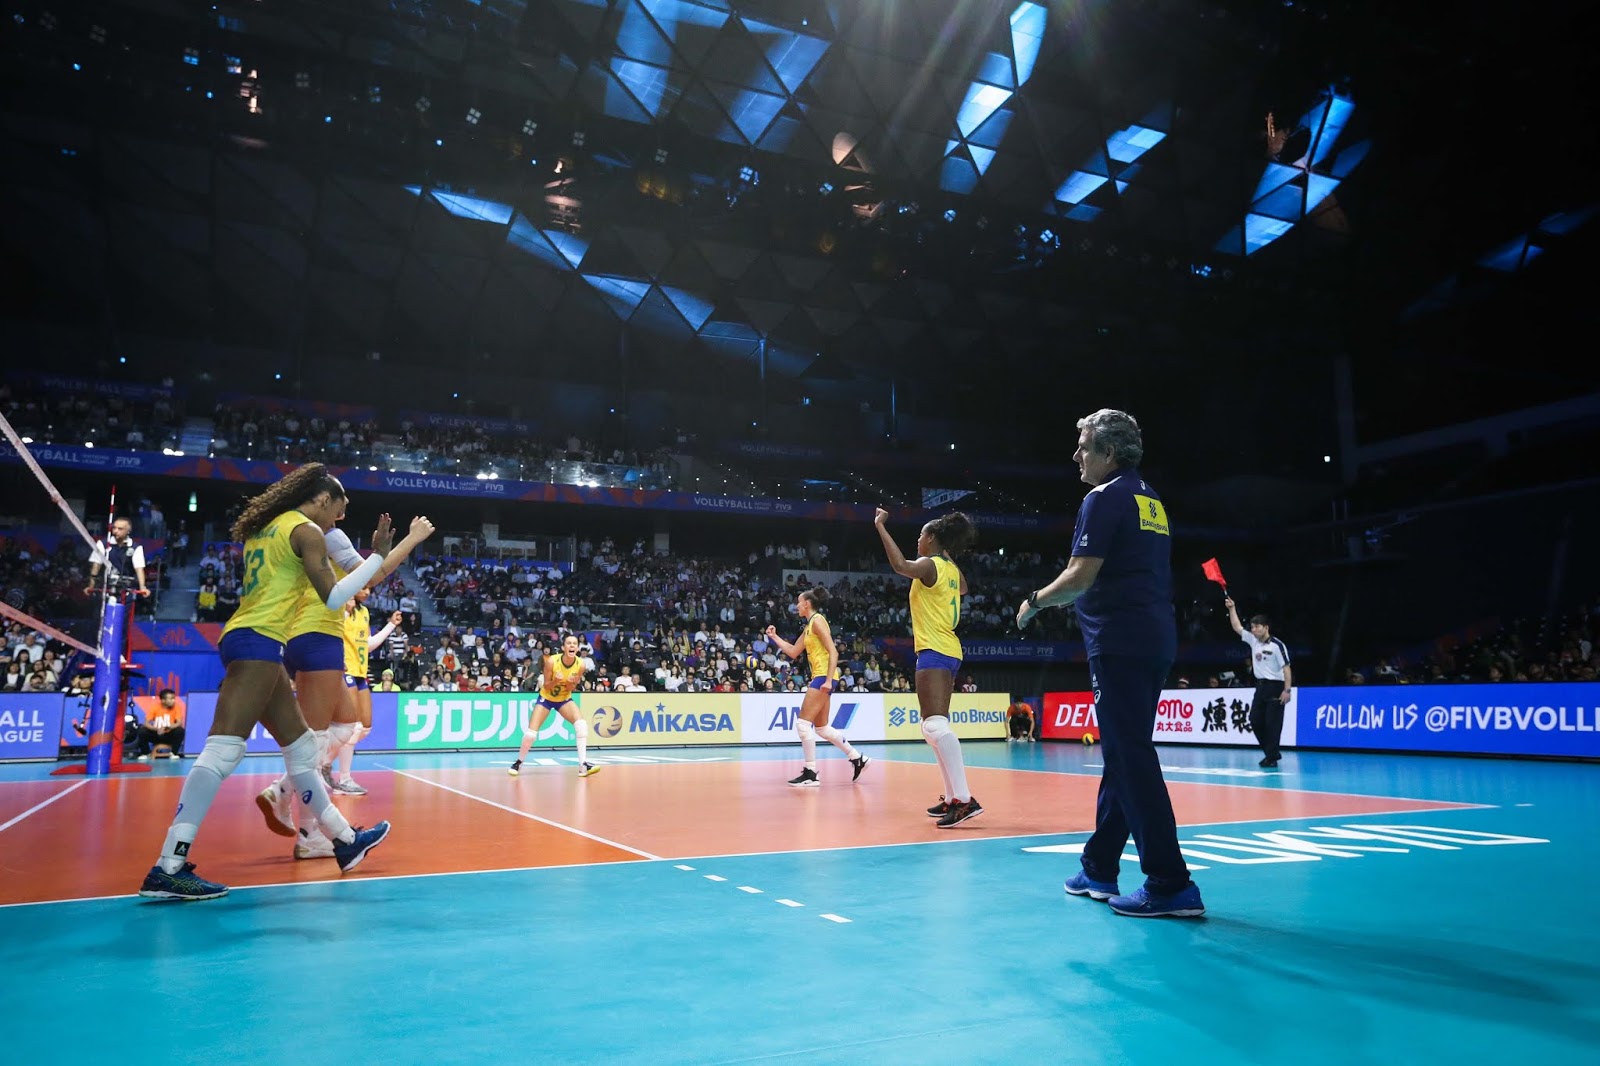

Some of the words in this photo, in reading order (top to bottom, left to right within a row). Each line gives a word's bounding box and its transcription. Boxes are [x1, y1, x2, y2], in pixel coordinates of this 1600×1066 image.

[386, 477, 458, 490] VOLLEYBALL
[694, 497, 753, 509] VOLLEYBALL
[962, 646, 1014, 656] OLLEYBALL
[0, 710, 45, 727] ALL
[953, 711, 968, 724] DO
[969, 709, 1007, 724] BRASIL
[1316, 704, 1384, 729] FOLLOW
[1393, 703, 1418, 731] US
[1156, 721, 1193, 732] 丸大食品
